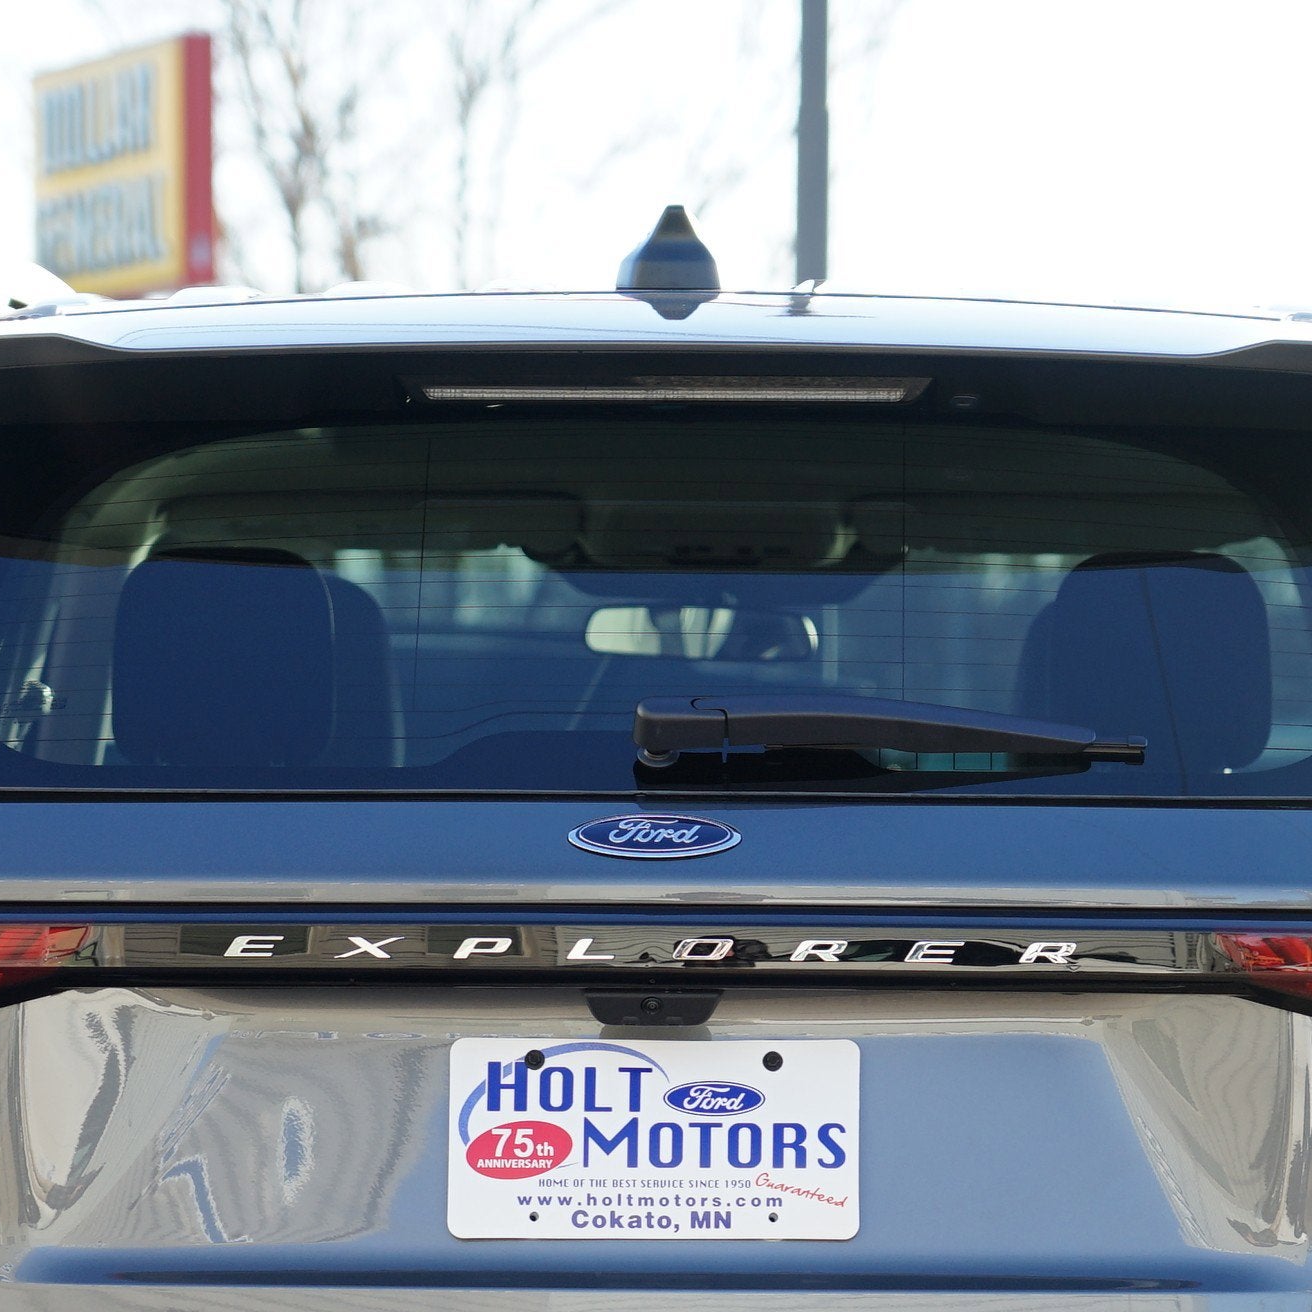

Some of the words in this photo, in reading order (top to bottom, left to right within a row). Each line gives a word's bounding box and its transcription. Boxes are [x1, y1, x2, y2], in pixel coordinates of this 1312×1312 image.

[608, 818, 702, 844] Ford
[223, 934, 1077, 964] EXPLORER
[487, 1061, 652, 1112] HOLT
[683, 1080, 745, 1111] Ford
[491, 1128, 555, 1158] 75th
[582, 1117, 847, 1169] MOTORS
[476, 1158, 554, 1170] ANNIVERSARY
[538, 1178, 570, 1188] HOME
[573, 1178, 586, 1188] OF
[590, 1178, 608, 1188] THE
[612, 1179, 637, 1188] BEST
[641, 1179, 684, 1188] SERVICE
[688, 1179, 720, 1189] SINCE
[725, 1179, 752, 1189] 1950
[755, 1172, 849, 1208] Guaranteed
[517, 1192, 783, 1208] www.holtmotors.com
[571, 1209, 681, 1233] Cokato,
[690, 1211, 732, 1229] MN
